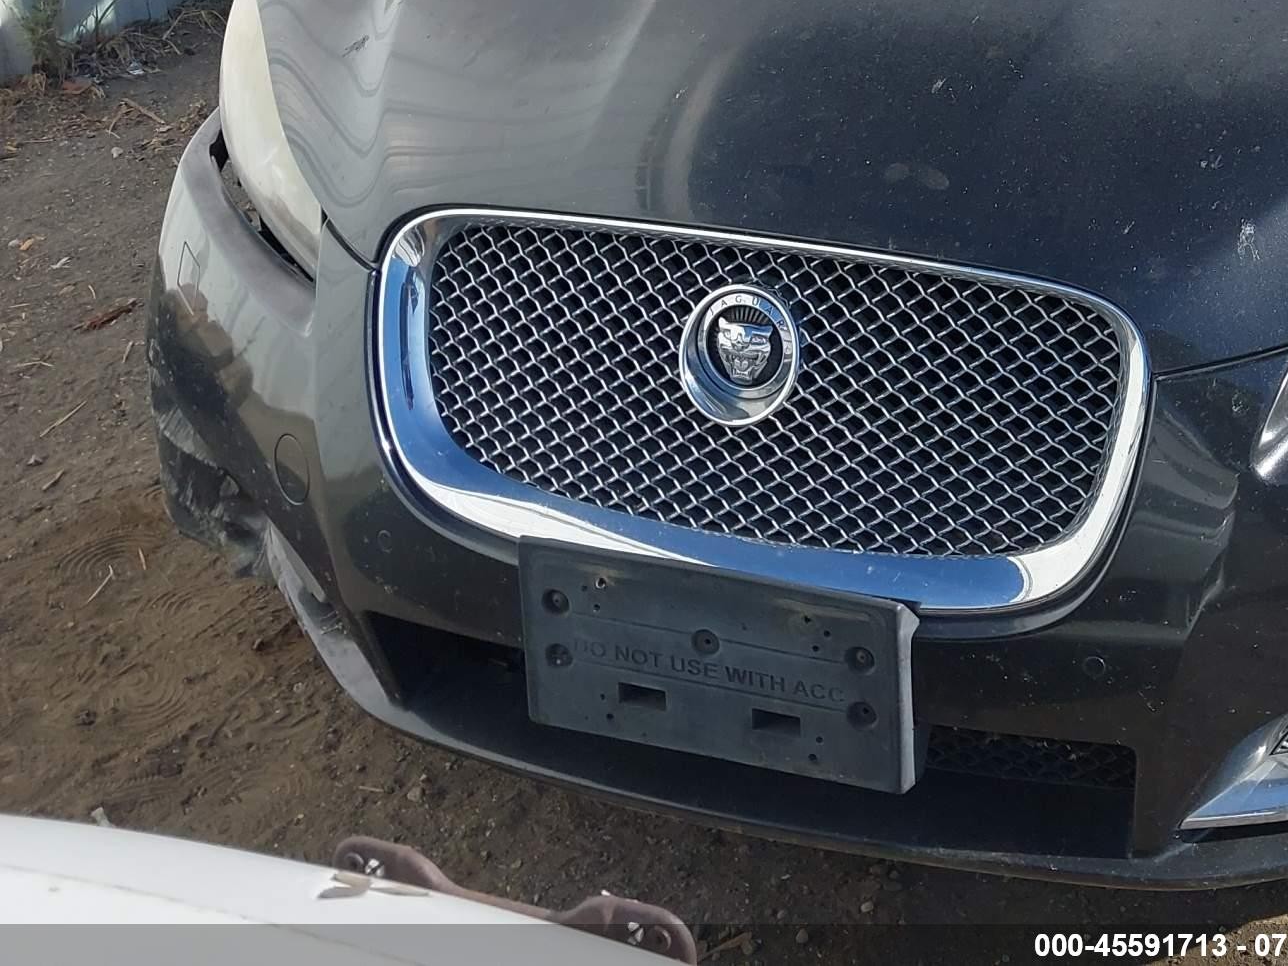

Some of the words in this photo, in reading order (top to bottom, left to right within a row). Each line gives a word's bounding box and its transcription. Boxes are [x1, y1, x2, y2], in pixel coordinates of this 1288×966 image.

[710, 296, 787, 331] JAGUAR
[573, 637, 607, 658] DO
[615, 644, 665, 668] NOT
[670, 654, 720, 679] USE
[725, 665, 785, 693] WITH
